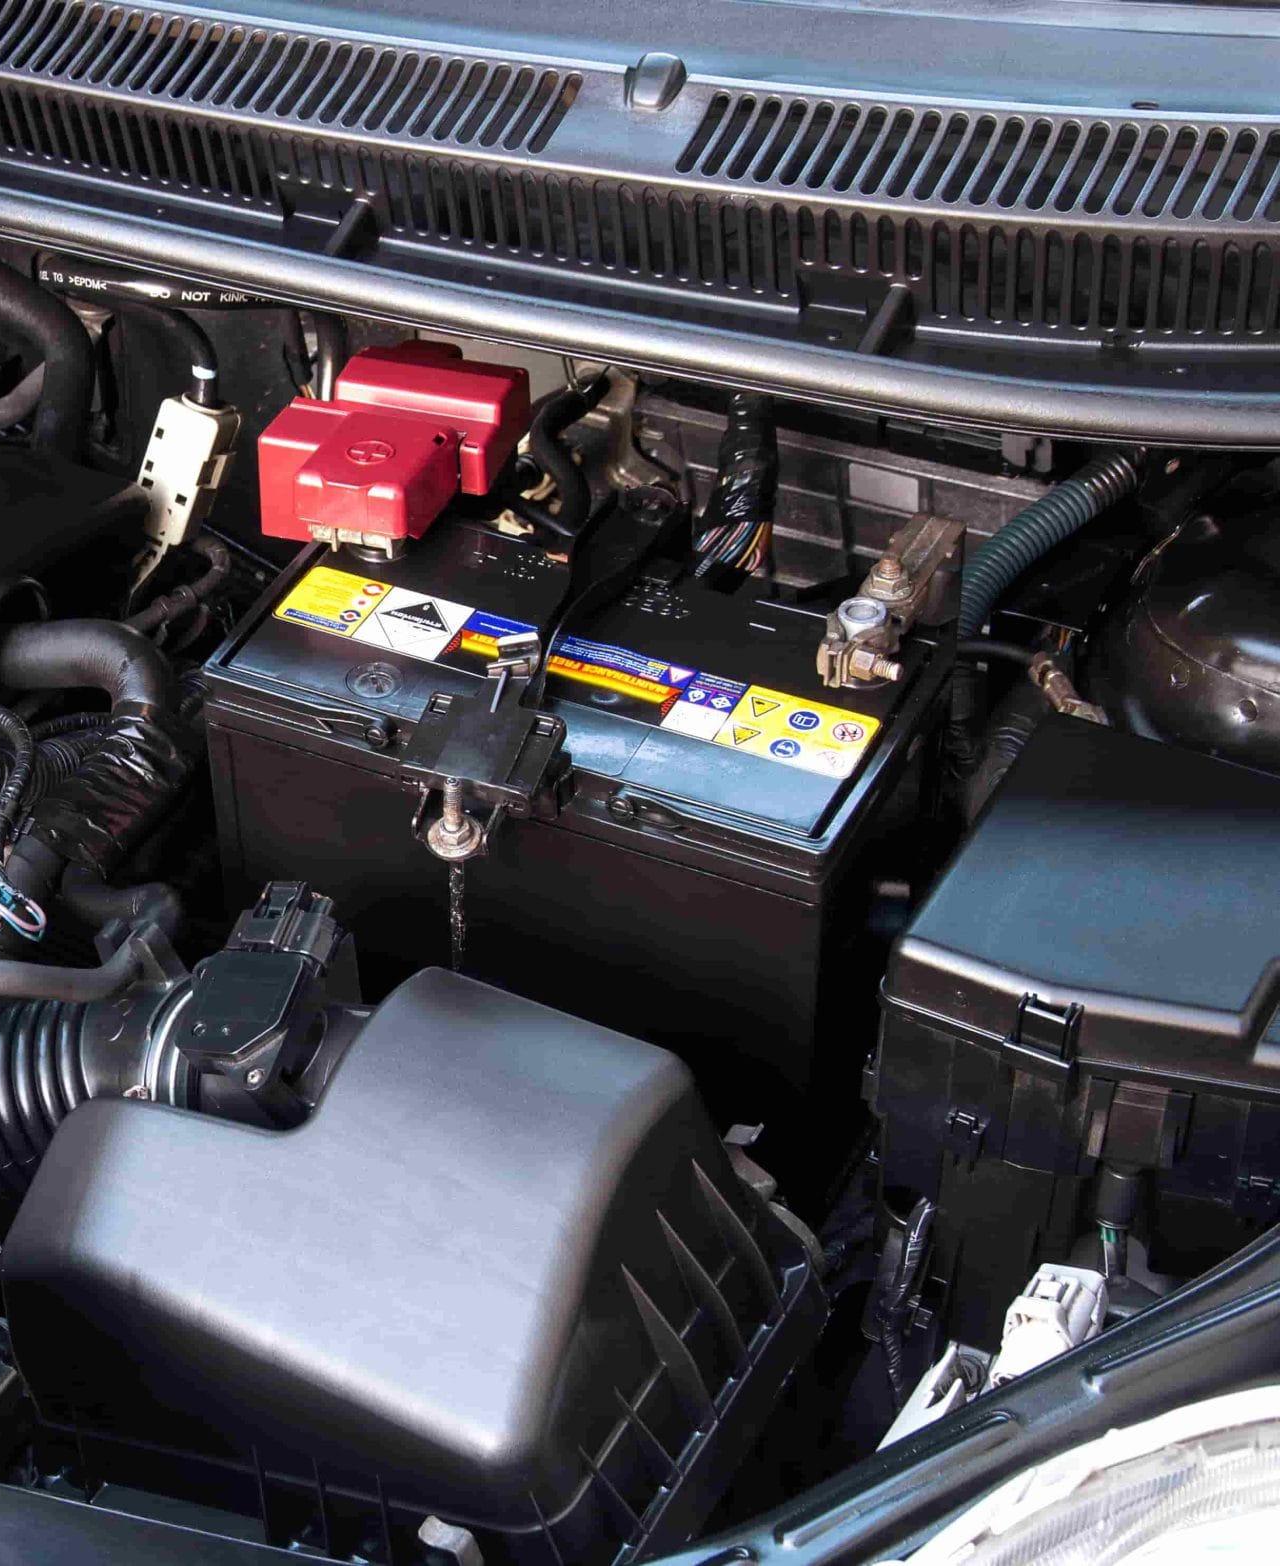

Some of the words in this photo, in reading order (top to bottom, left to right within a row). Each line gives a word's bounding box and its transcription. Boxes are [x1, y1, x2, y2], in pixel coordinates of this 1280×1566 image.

[53, 272, 63, 283] TG
[181, 291, 210, 302] NOT
[582, 664, 669, 694] MAINTENANCE
